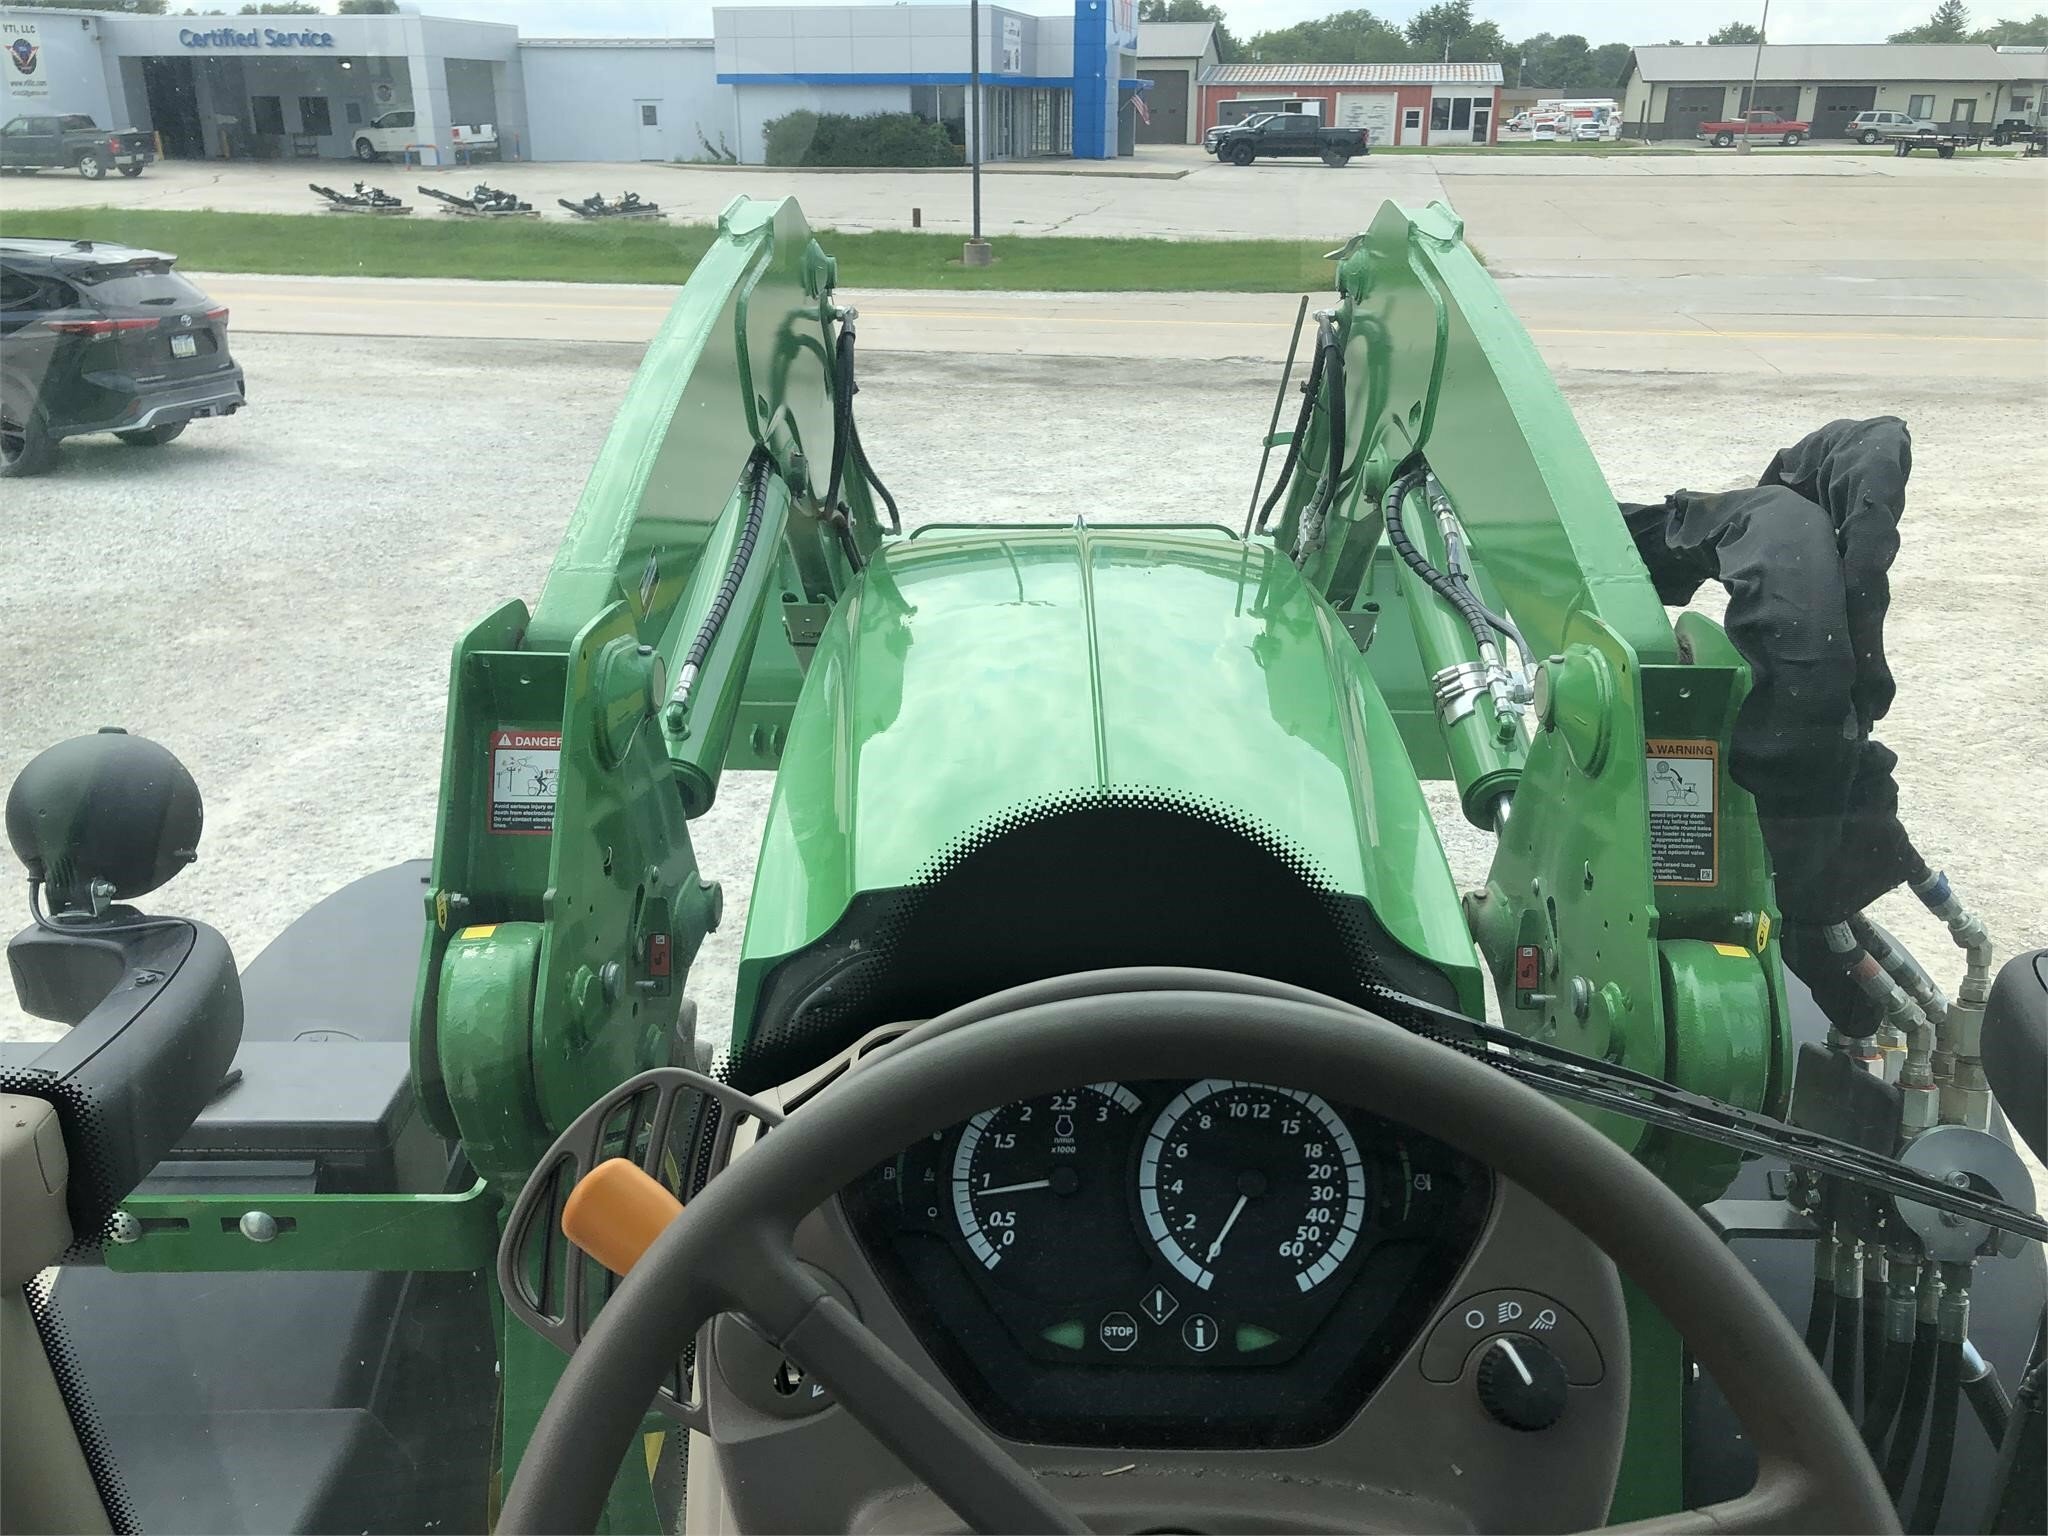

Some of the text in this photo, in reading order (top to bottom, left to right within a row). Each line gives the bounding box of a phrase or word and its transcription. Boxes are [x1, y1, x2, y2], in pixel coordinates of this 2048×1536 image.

[21, 24, 36, 34] LLC
[179, 28, 334, 48] Certified Service
[1656, 745, 1713, 756] WARNING
[1051, 1096, 1077, 1110] 2.5
[1229, 1102, 1248, 1118] 10
[1020, 1107, 1032, 1121] 2
[1096, 1107, 1108, 1122] 3
[1252, 1104, 1270, 1118] 12
[1200, 1116, 1212, 1129] 8
[1281, 1120, 1300, 1134] 15
[994, 1134, 1016, 1148] 1.5
[1176, 1143, 1188, 1158] 6
[1304, 1144, 1322, 1158] 18
[1307, 1164, 1332, 1179] 20
[982, 1173, 990, 1188] 1
[1171, 1180, 1183, 1194] 4
[1310, 1186, 1334, 1200] 30
[990, 1212, 1016, 1226] 0.5
[1184, 1214, 1196, 1229] 2
[1306, 1208, 1330, 1223] 40
[1002, 1230, 1014, 1245] 0
[1296, 1226, 1320, 1241] 50
[1279, 1242, 1304, 1256] 60
[1104, 1326, 1134, 1336] STOP
